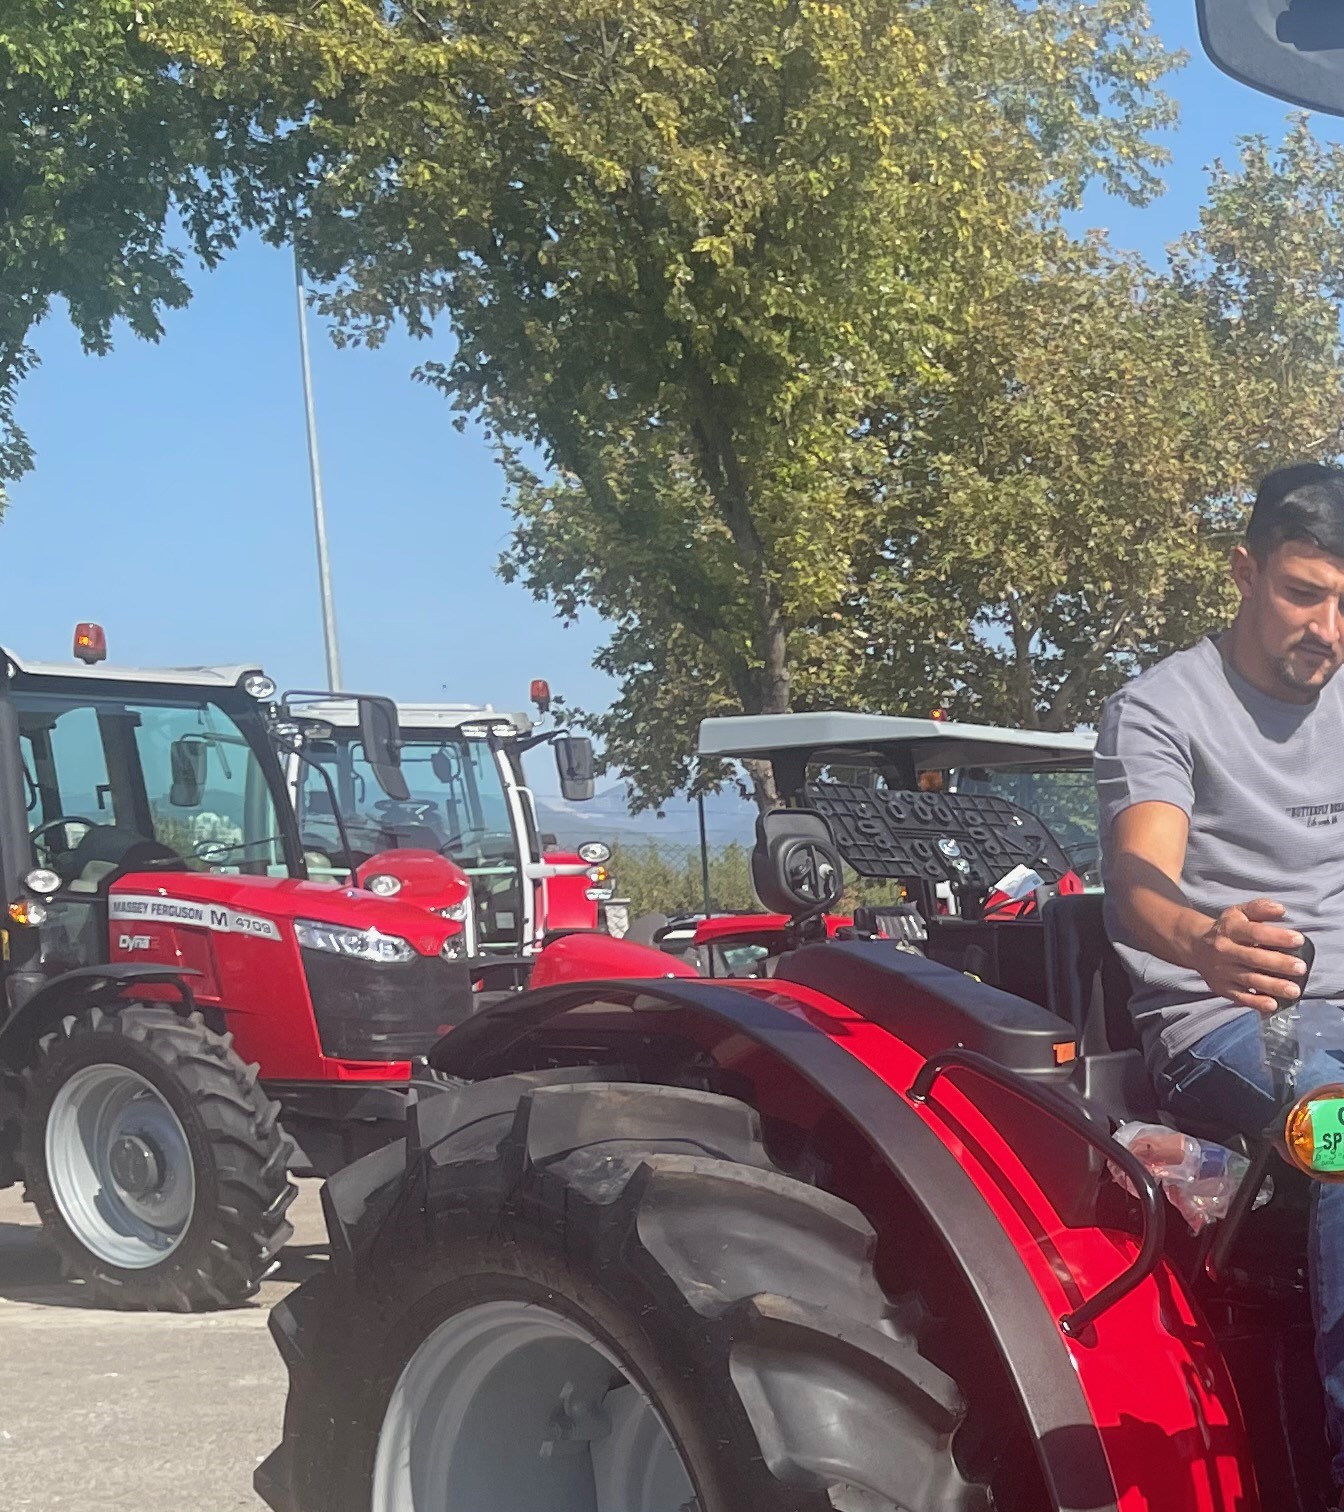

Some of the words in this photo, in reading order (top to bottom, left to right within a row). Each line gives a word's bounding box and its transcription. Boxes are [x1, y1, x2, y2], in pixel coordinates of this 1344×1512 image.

[113, 902, 148, 914] MASSEY
[151, 903, 204, 921] FERGUSON
[210, 910, 228, 927] M
